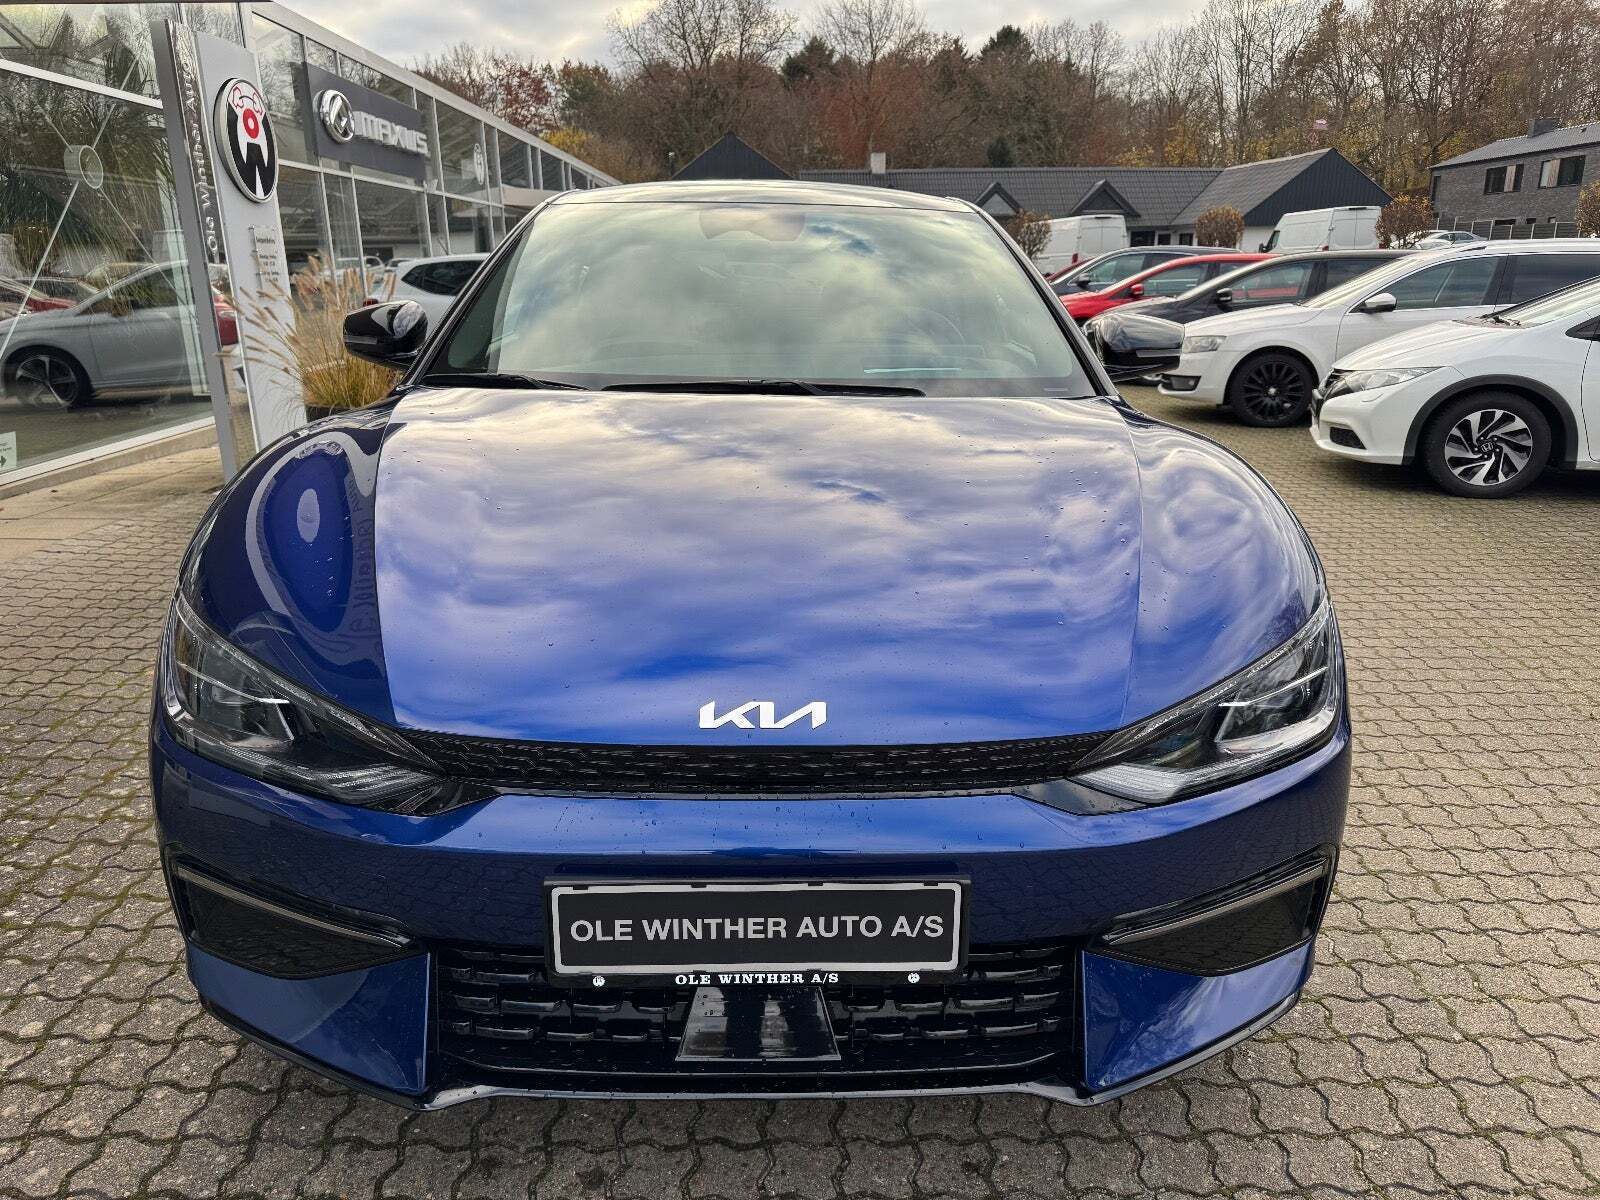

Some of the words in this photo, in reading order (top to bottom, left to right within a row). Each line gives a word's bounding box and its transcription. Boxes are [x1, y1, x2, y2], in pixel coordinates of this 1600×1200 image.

[352, 110, 430, 155] MAXUS
[191, 122, 212, 210] Winther
[205, 216, 219, 251] Ole
[699, 700, 827, 730] KIA
[570, 919, 633, 942] OLE
[642, 917, 787, 941] WINTHER
[796, 915, 882, 938] AUTO
[891, 915, 944, 938] A/S
[675, 974, 711, 985] OLE
[719, 973, 804, 984] WINTHER
[811, 973, 839, 984] A/S
